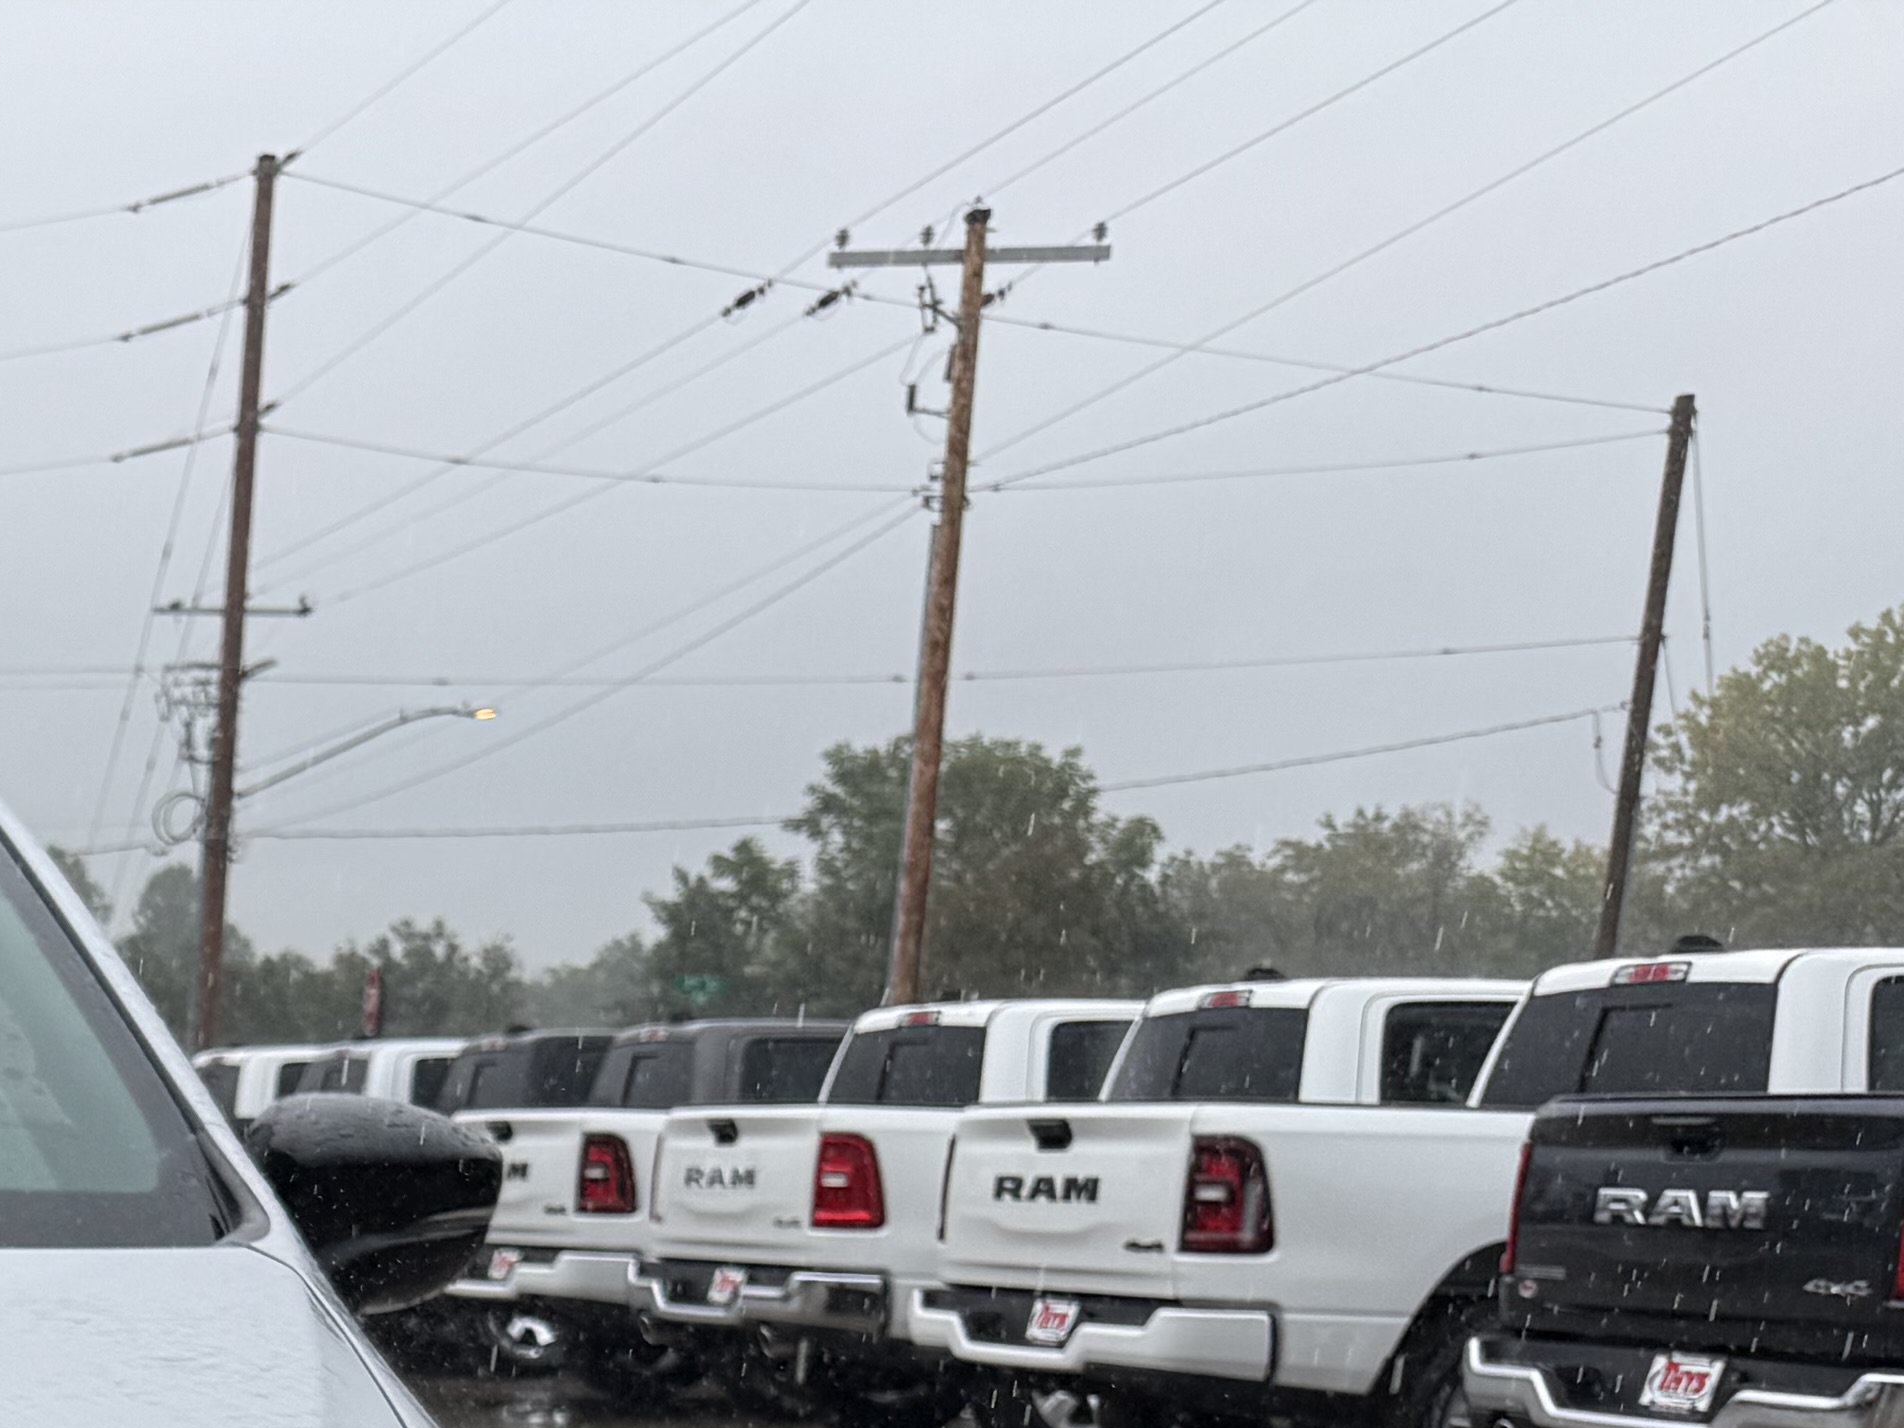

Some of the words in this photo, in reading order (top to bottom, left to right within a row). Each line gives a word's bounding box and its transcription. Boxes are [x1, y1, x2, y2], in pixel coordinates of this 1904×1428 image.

[683, 1167, 756, 1189] RAM
[993, 1175, 1100, 1203] RAM
[1592, 1186, 1771, 1230] RAM
